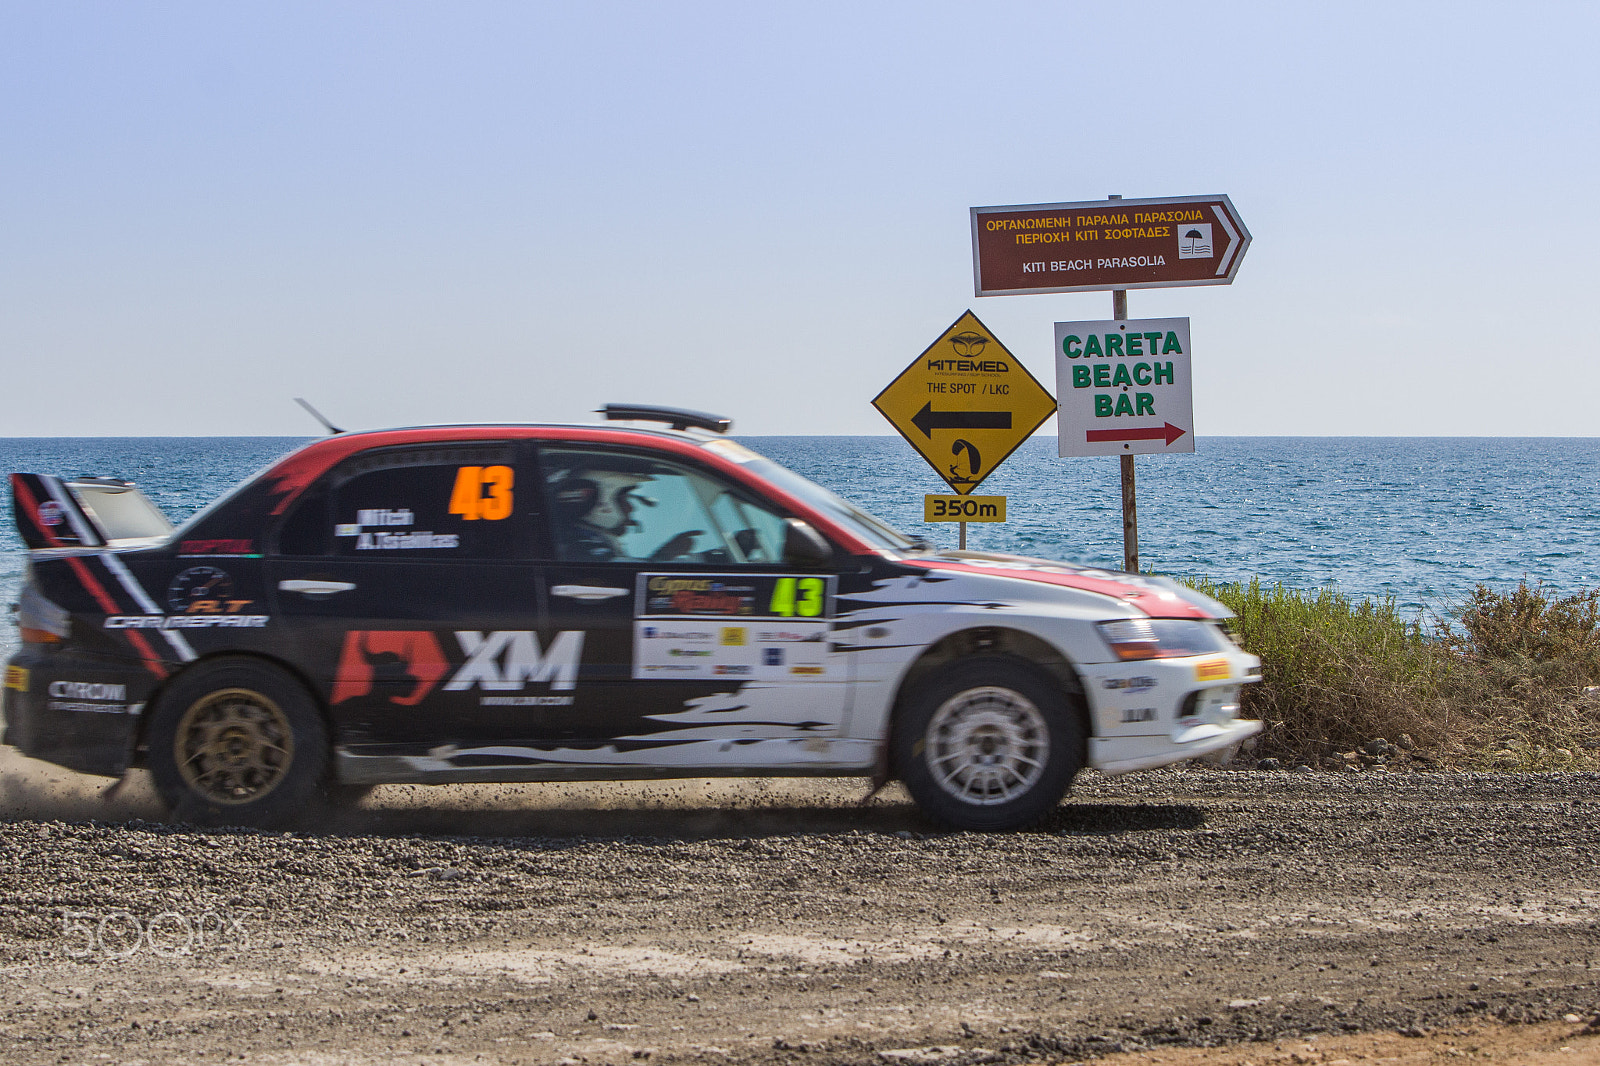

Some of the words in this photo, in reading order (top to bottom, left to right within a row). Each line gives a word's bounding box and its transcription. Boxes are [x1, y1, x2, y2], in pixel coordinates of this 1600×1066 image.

[986, 216, 1071, 231] ΟΡΓΑΝΩΜΕΝΗ
[1077, 213, 1129, 227] ΠΑΡΑΛΙΑ
[1135, 210, 1203, 224] ΠΑΡΑΣΟΛΙΑ
[1015, 232, 1070, 245] ΠΕΡΙΟΧΗ
[1075, 230, 1099, 242] ΚΙΤΙ
[1104, 226, 1170, 240] ΣΟΦΤΑΔΕΣ
[1022, 261, 1046, 273] KITI
[1050, 259, 1092, 272] BEACH
[1097, 255, 1166, 269] PARASOLIA
[1062, 331, 1183, 359] CARETA
[927, 359, 1009, 372] KITEMED
[1072, 361, 1174, 388] BEACH
[927, 382, 947, 393] THE
[949, 382, 977, 394] SPOT
[990, 384, 1010, 395] LKC
[1094, 392, 1156, 417] BAR
[448, 465, 515, 520] 43
[933, 500, 998, 517] 350m
[769, 577, 825, 617] 43
[103, 615, 165, 629] CAR
[164, 615, 270, 629] REPAIR
[442, 630, 586, 691] XM
